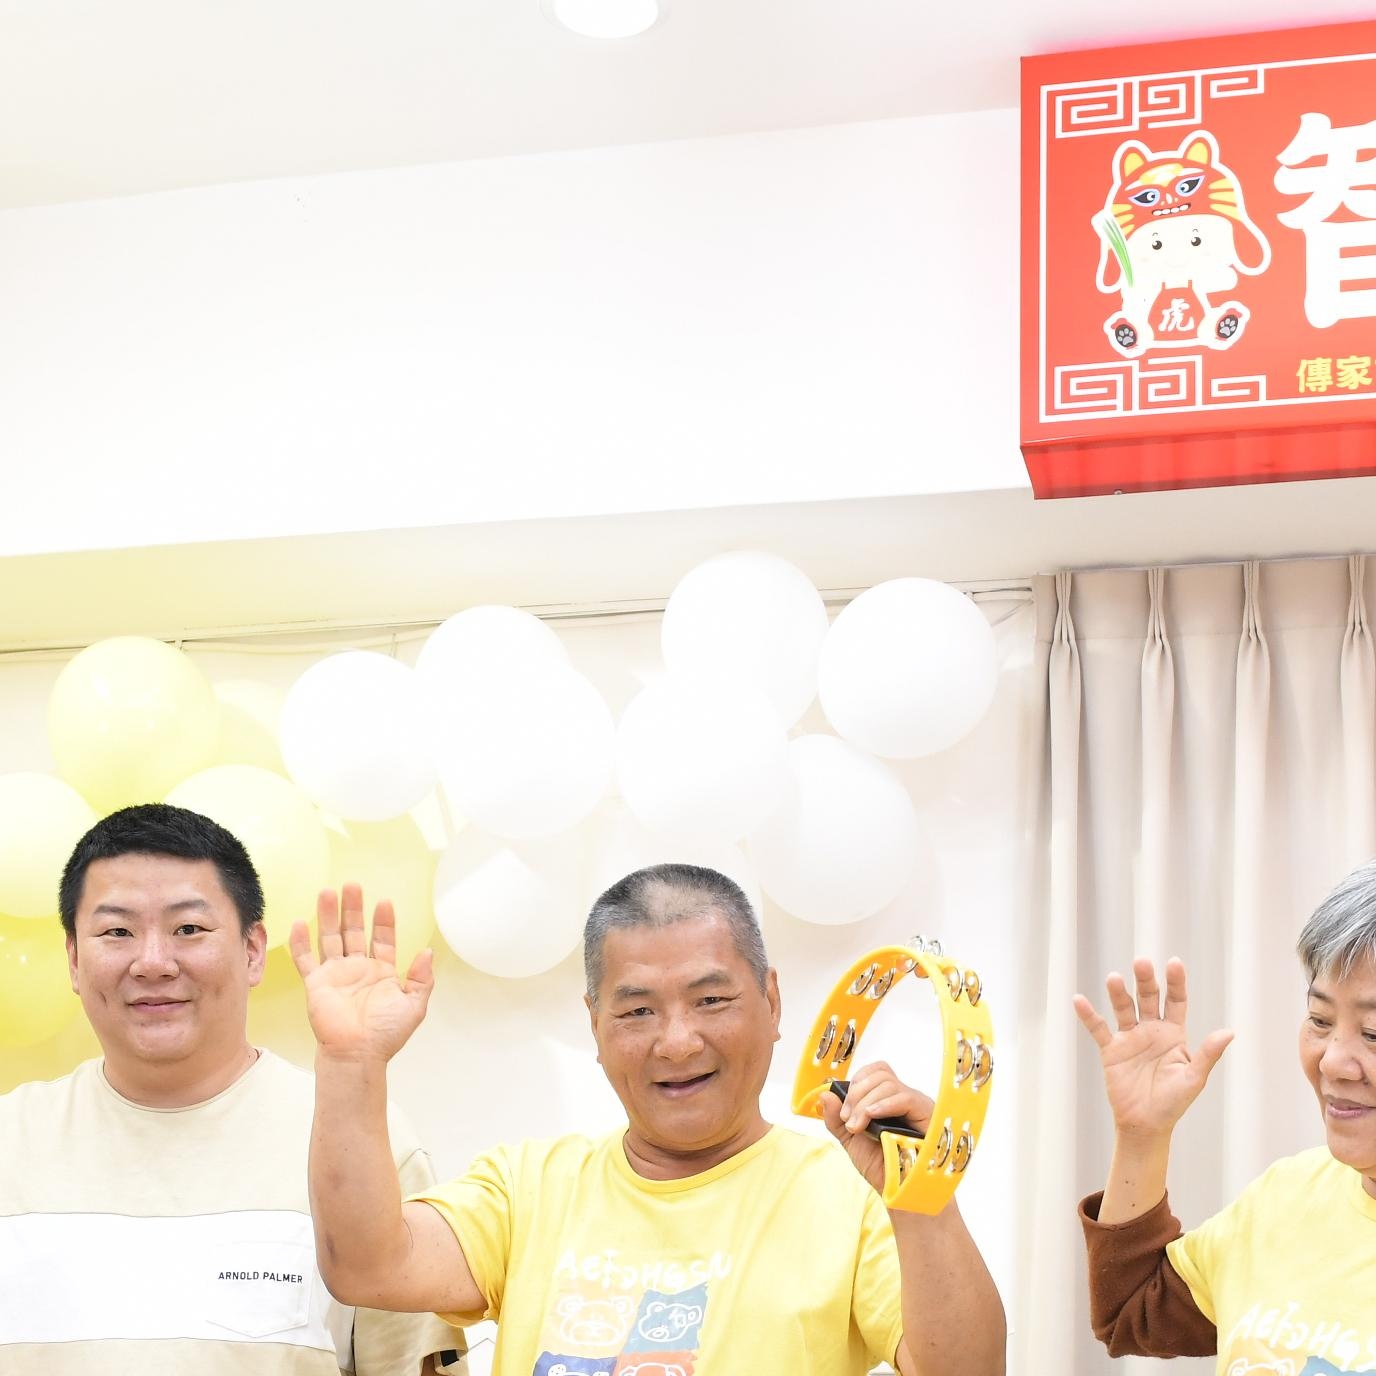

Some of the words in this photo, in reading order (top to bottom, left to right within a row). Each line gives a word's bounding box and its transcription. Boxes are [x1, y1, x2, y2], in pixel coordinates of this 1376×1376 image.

[1158, 298, 1195, 332] 虎
[218, 1271, 260, 1281] ARNOLD
[262, 1271, 303, 1285] PALMER
